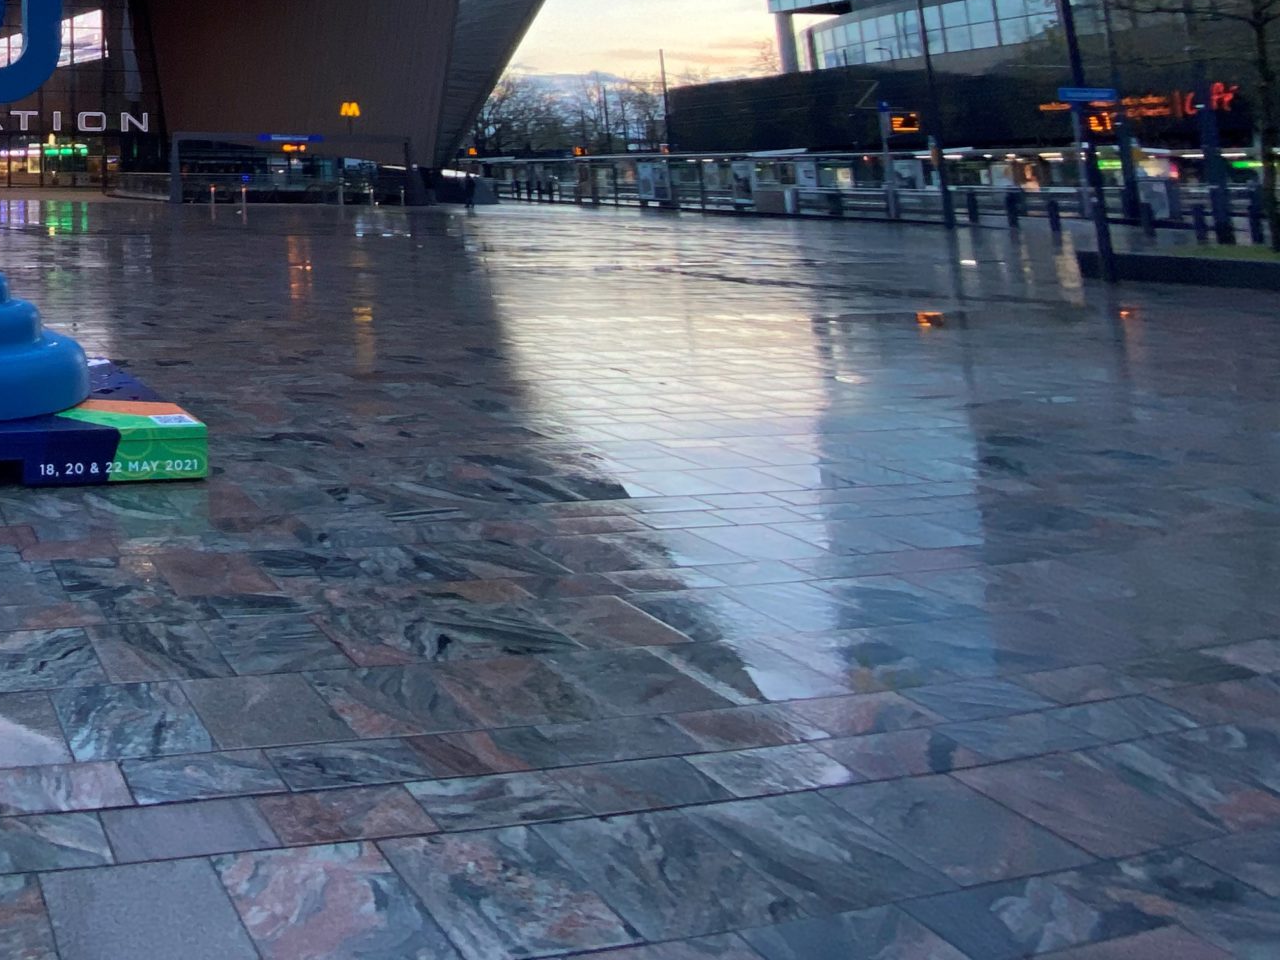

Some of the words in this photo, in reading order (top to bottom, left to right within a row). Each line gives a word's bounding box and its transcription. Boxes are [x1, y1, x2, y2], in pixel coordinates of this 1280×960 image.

[39, 463, 59, 477] 18,
[65, 462, 84, 475] 20
[90, 462, 99, 474] &
[105, 461, 123, 473] 22
[128, 460, 159, 472] MAY
[165, 459, 198, 471] 2021
